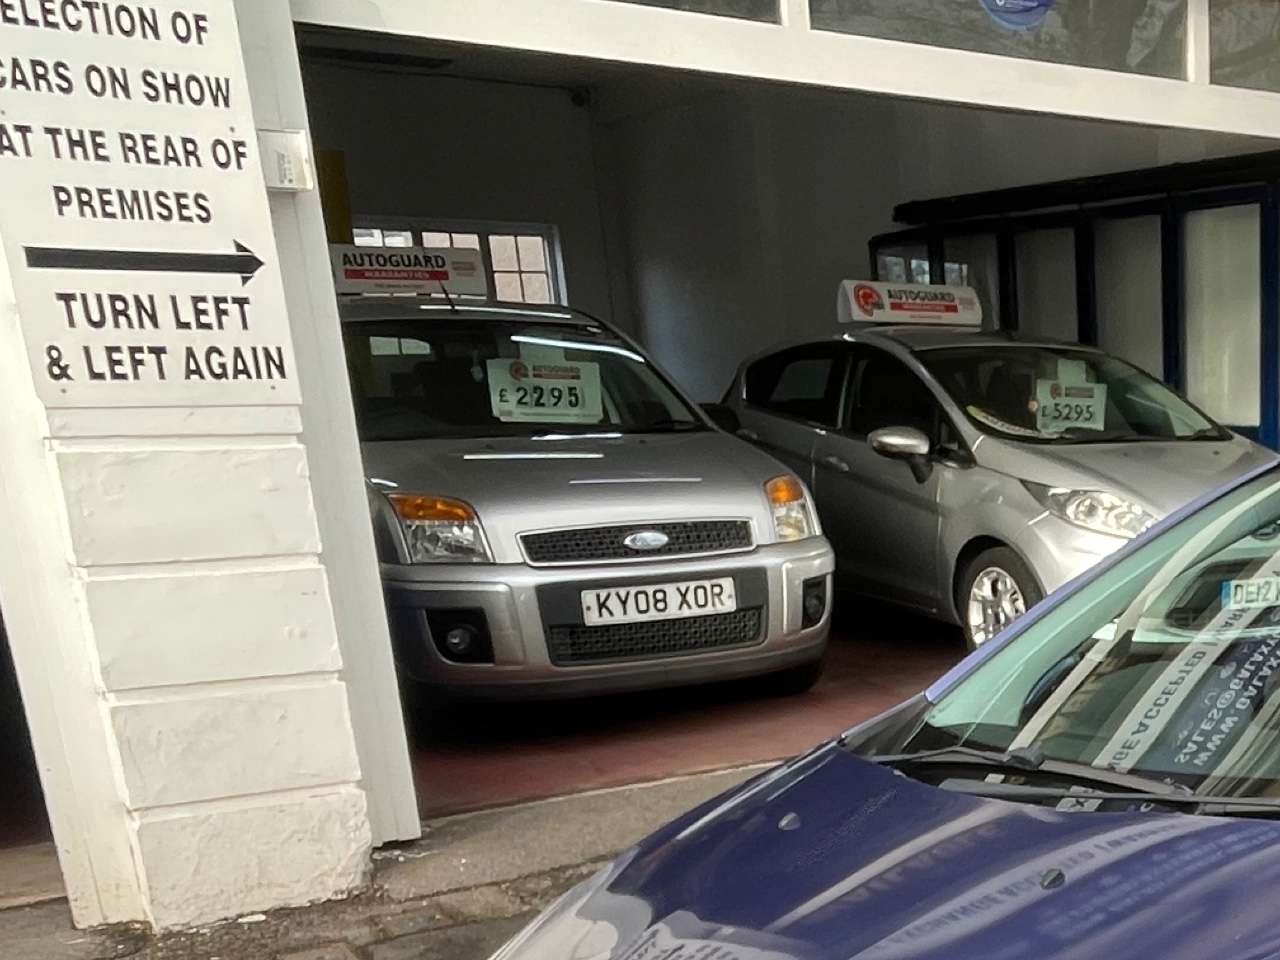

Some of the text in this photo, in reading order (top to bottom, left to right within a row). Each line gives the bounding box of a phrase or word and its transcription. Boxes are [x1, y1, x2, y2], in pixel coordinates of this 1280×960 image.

[171, 11, 208, 45] OF
[85, 64, 132, 100] ON
[142, 69, 231, 108] SHOW
[0, 123, 247, 171] AT THE REAR OF
[53, 186, 212, 224] PREMISES
[342, 253, 446, 269] AUTOGUARD
[55, 292, 250, 331] TURN LEFT
[46, 345, 287, 382] & LEFT AGAIN
[595, 583, 725, 618] KY08 XOR
